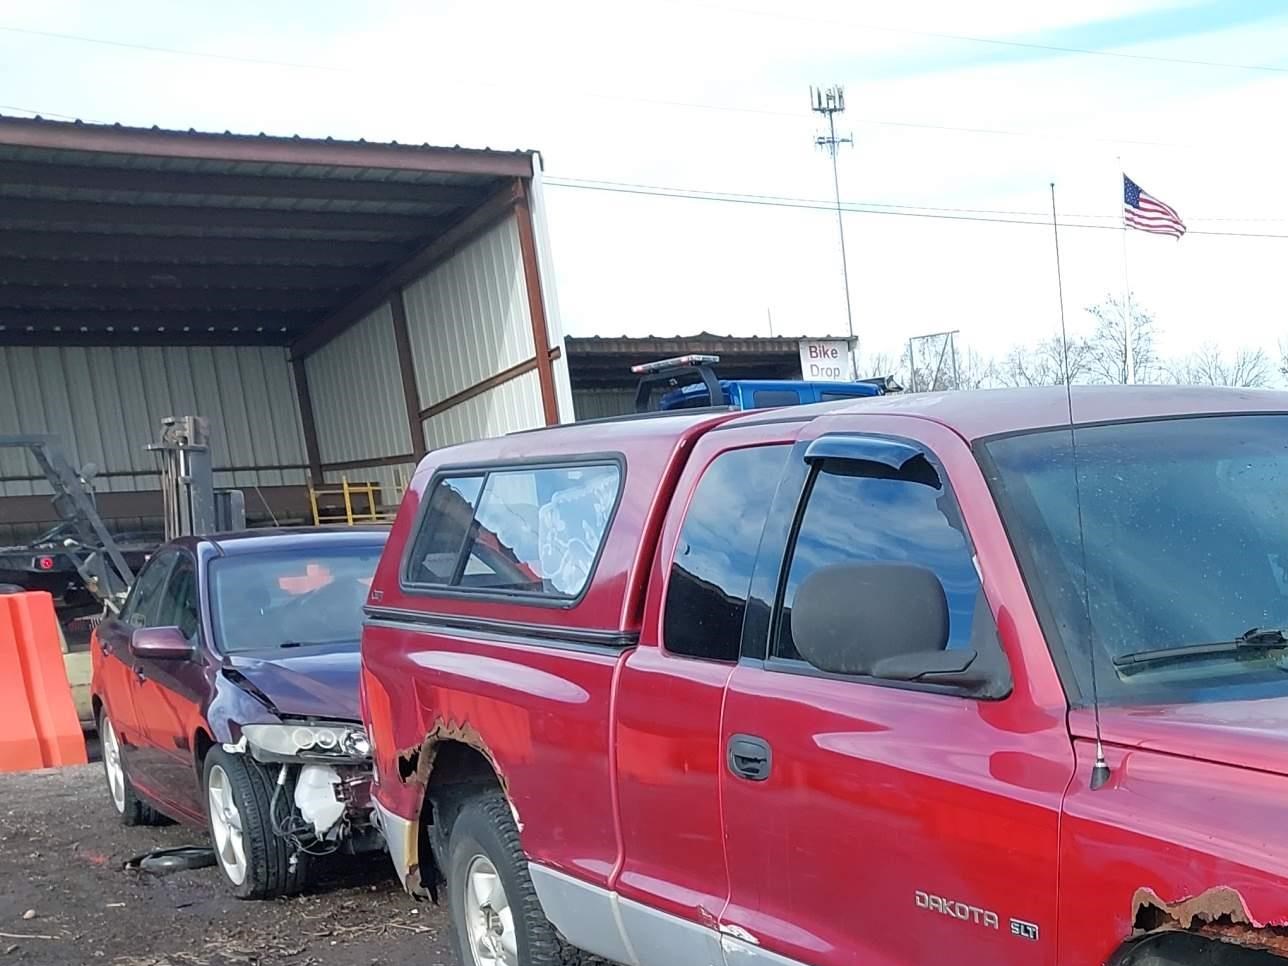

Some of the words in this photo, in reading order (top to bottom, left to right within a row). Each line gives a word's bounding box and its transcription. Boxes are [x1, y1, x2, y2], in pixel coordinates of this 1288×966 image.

[809, 345, 839, 359] Bike
[810, 364, 840, 378] Drop
[915, 890, 999, 930] DAKOTA
[1010, 921, 1037, 939] SLT
